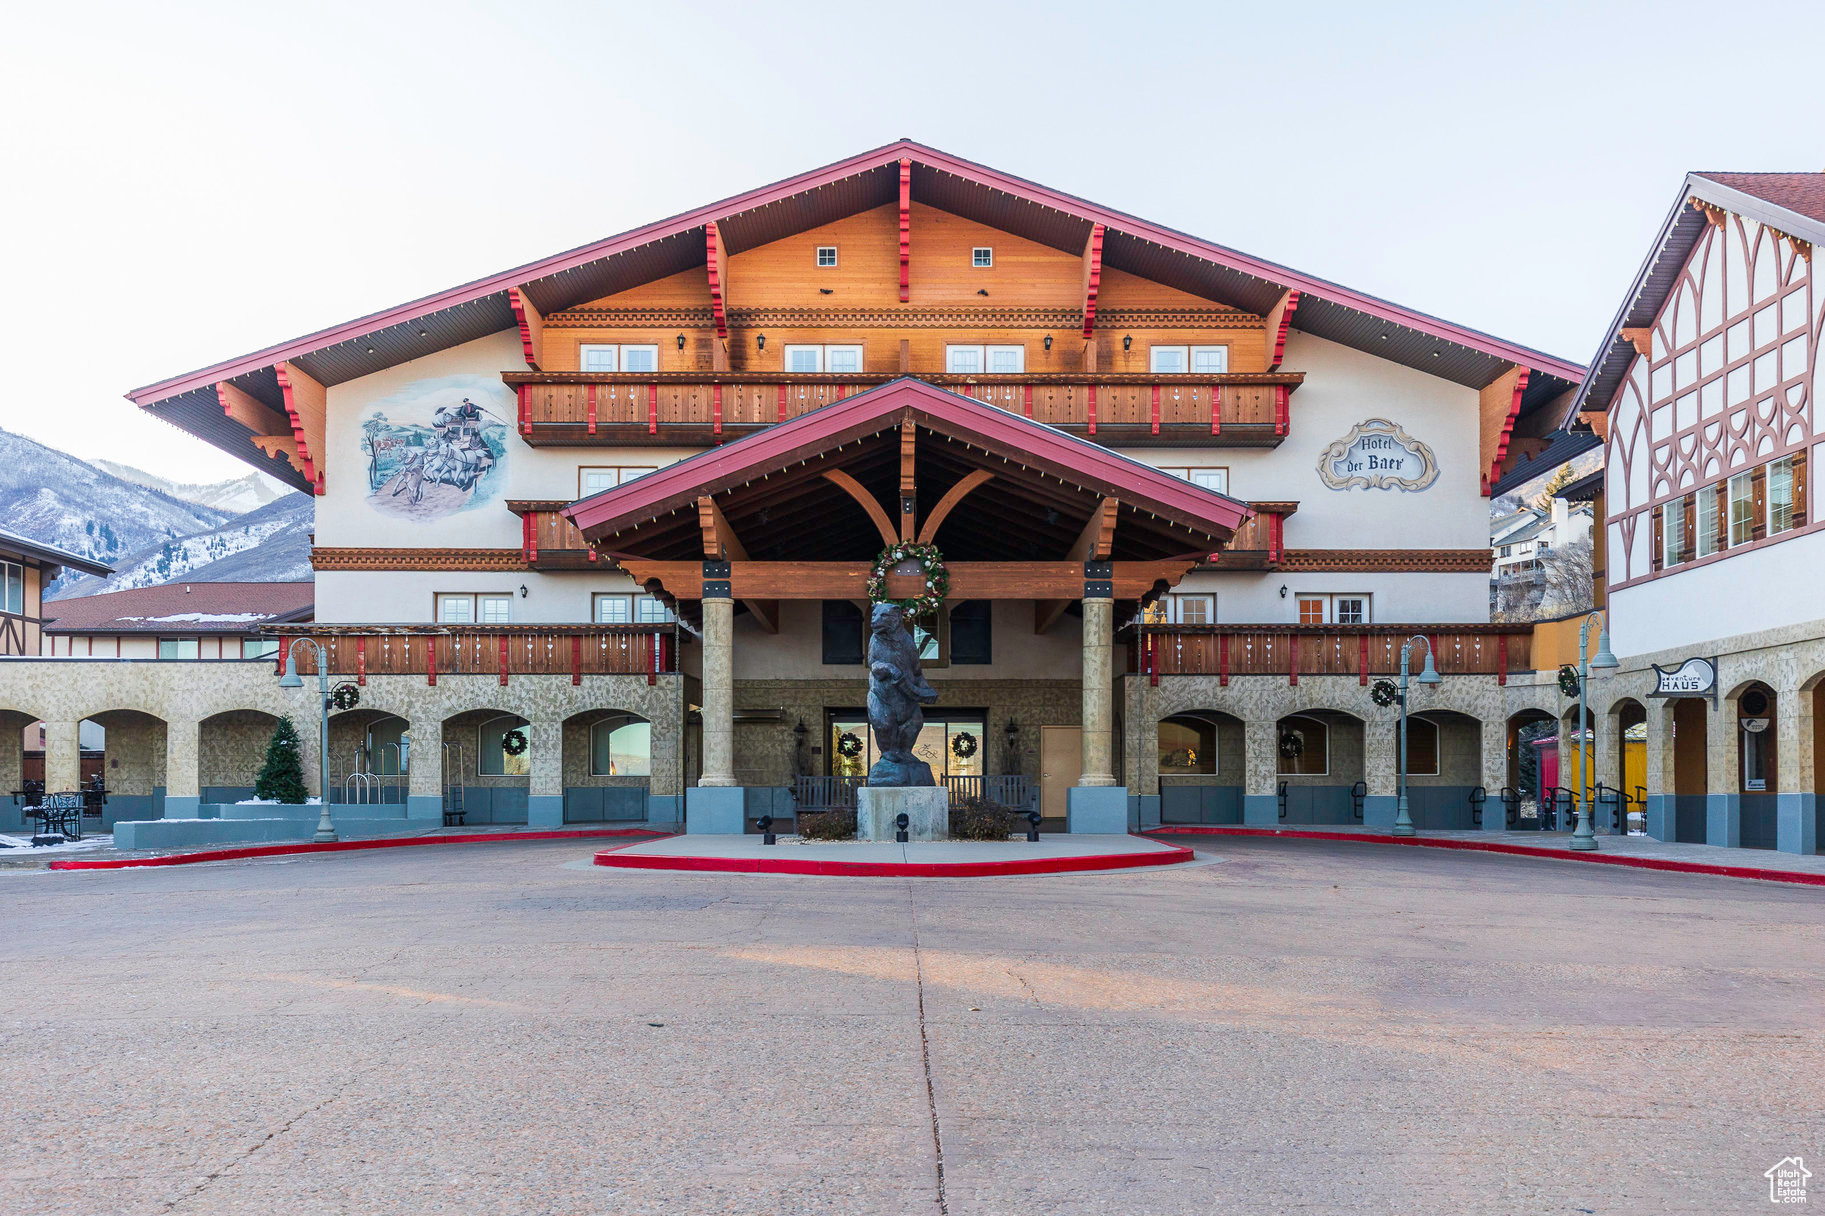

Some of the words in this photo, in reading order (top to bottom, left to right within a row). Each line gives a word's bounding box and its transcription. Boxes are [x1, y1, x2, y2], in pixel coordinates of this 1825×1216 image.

[1361, 438, 1392, 450] Hotel
[1347, 460, 1363, 472] der
[1368, 455, 1404, 471] Baer
[1662, 681, 1699, 690] HAUS
